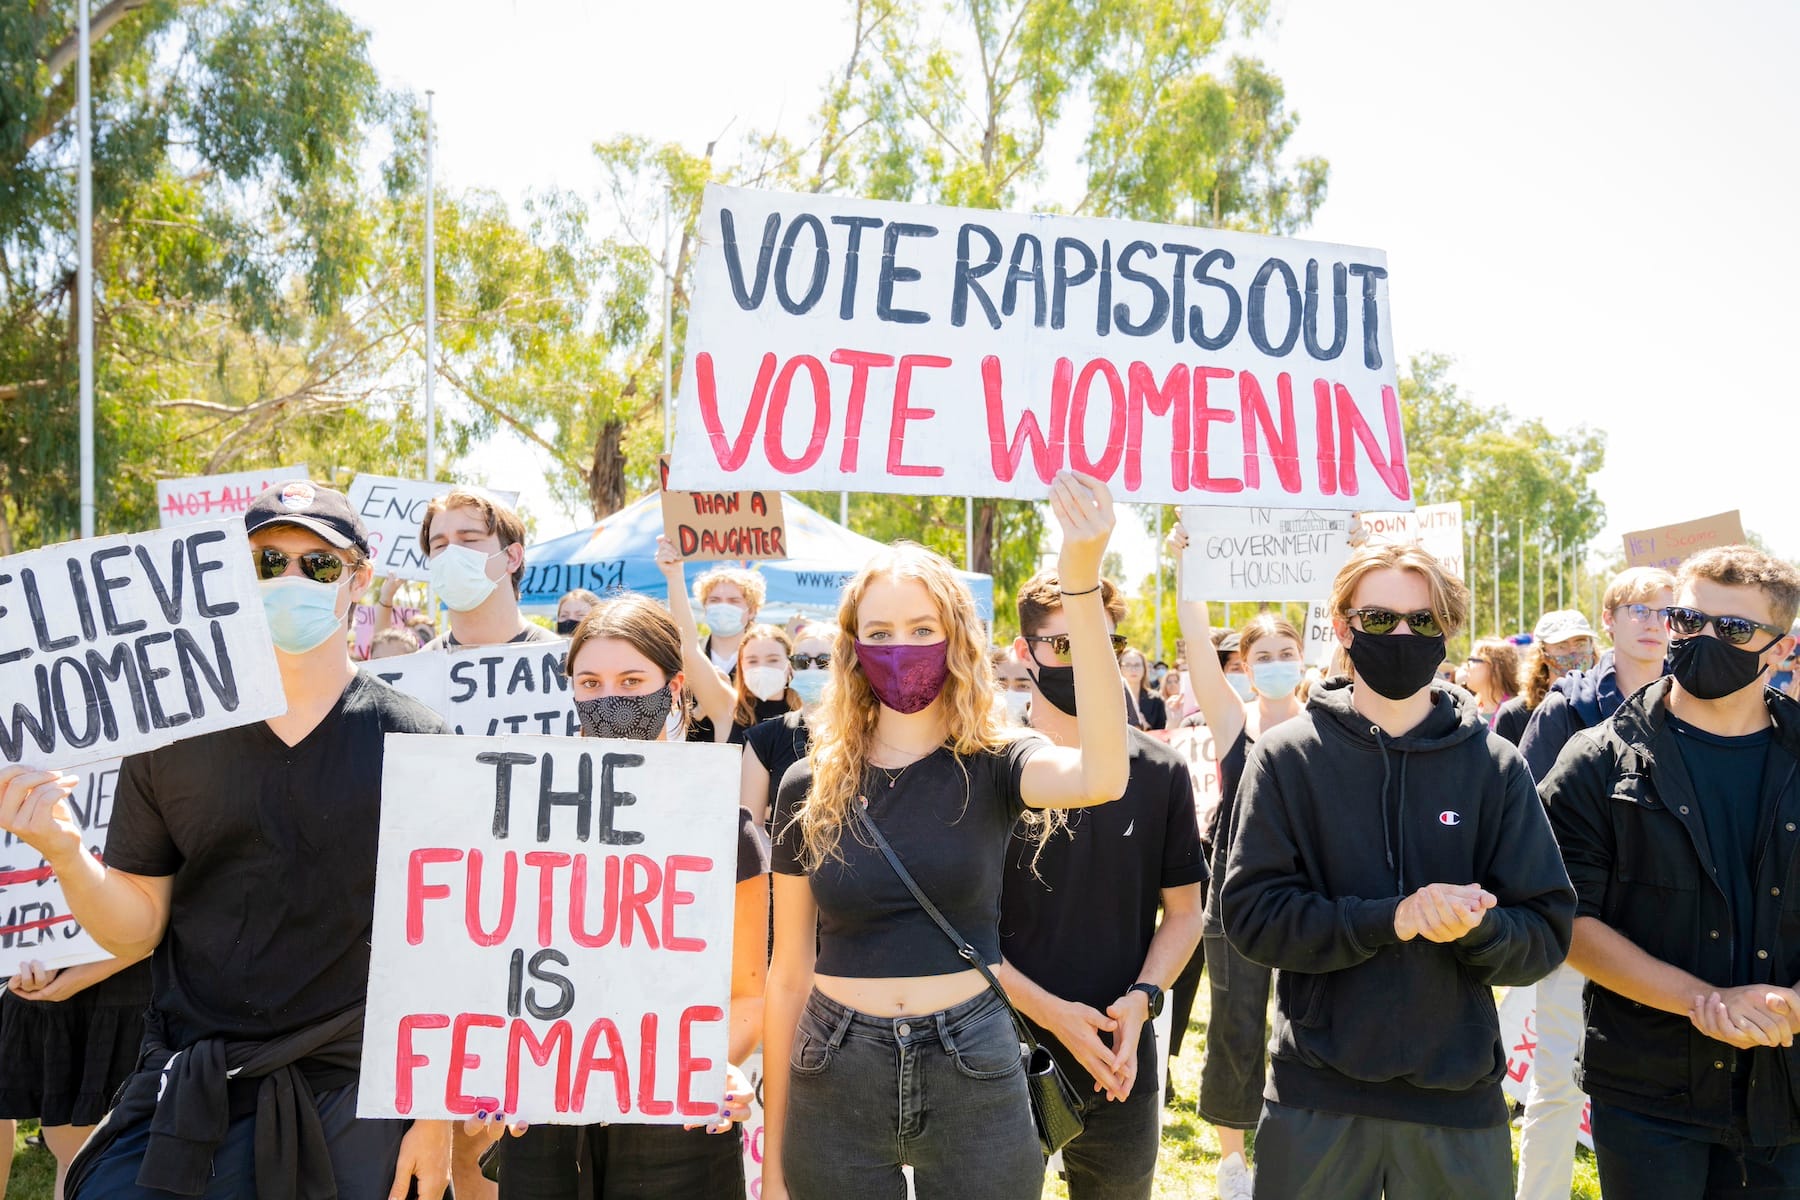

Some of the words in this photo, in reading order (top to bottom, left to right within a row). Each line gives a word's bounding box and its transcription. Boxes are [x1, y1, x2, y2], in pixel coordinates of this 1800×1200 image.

[720, 208, 940, 324] VOTE
[951, 223, 1242, 351] RAPISTS
[1247, 257, 1388, 370] OUT
[695, 348, 952, 477] VOTE
[981, 354, 1302, 494] WOMEN
[1313, 377, 1411, 501] IN
[164, 490, 212, 517] NOT
[360, 485, 429, 525] ENO
[688, 491, 740, 515] THAN
[750, 491, 768, 517] A
[1249, 507, 1272, 525] IN
[1417, 511, 1457, 529] WITH
[678, 524, 786, 557] DAUGHTER
[1206, 533, 1335, 560] GOVERNMENT
[0, 620, 240, 763] WOMEN
[450, 652, 568, 703] STAN
[475, 752, 646, 846] THE
[406, 848, 714, 952] FUTURE
[507, 948, 575, 1021] IS
[394, 1006, 724, 1116] FEMALE
